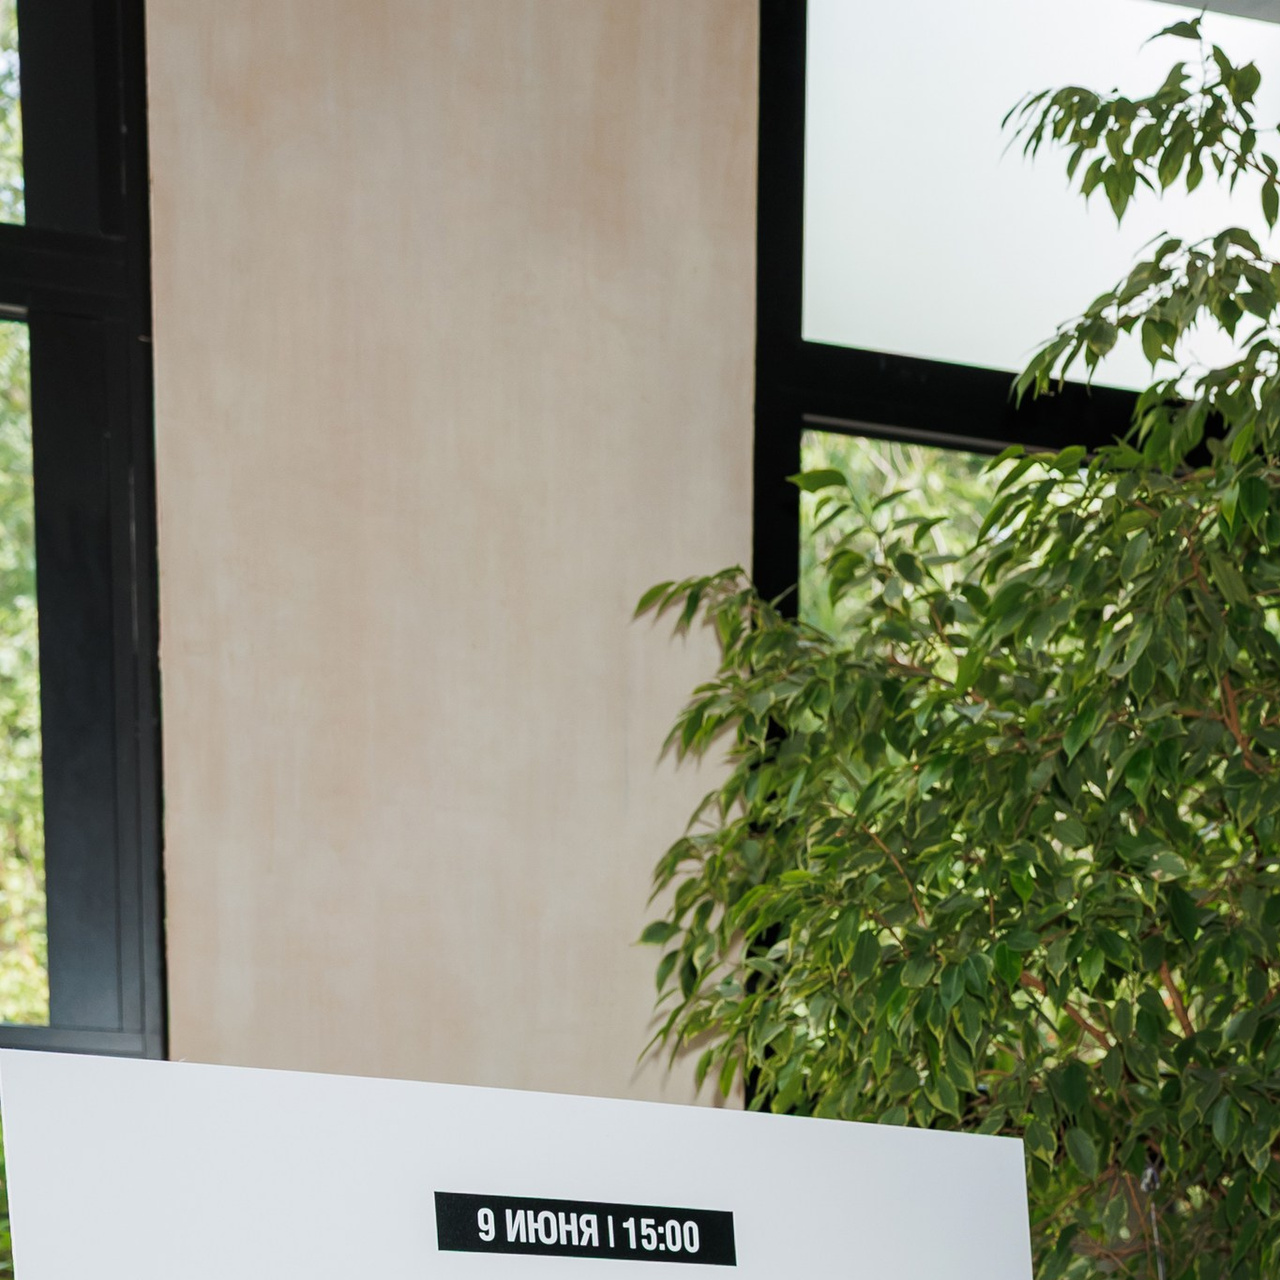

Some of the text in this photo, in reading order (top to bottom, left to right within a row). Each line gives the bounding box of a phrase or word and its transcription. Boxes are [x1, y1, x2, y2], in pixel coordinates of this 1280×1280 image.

[476, 1207, 496, 1242] 9
[504, 1208, 600, 1247] ИЮНЯ
[622, 1216, 701, 1254] 15:00
